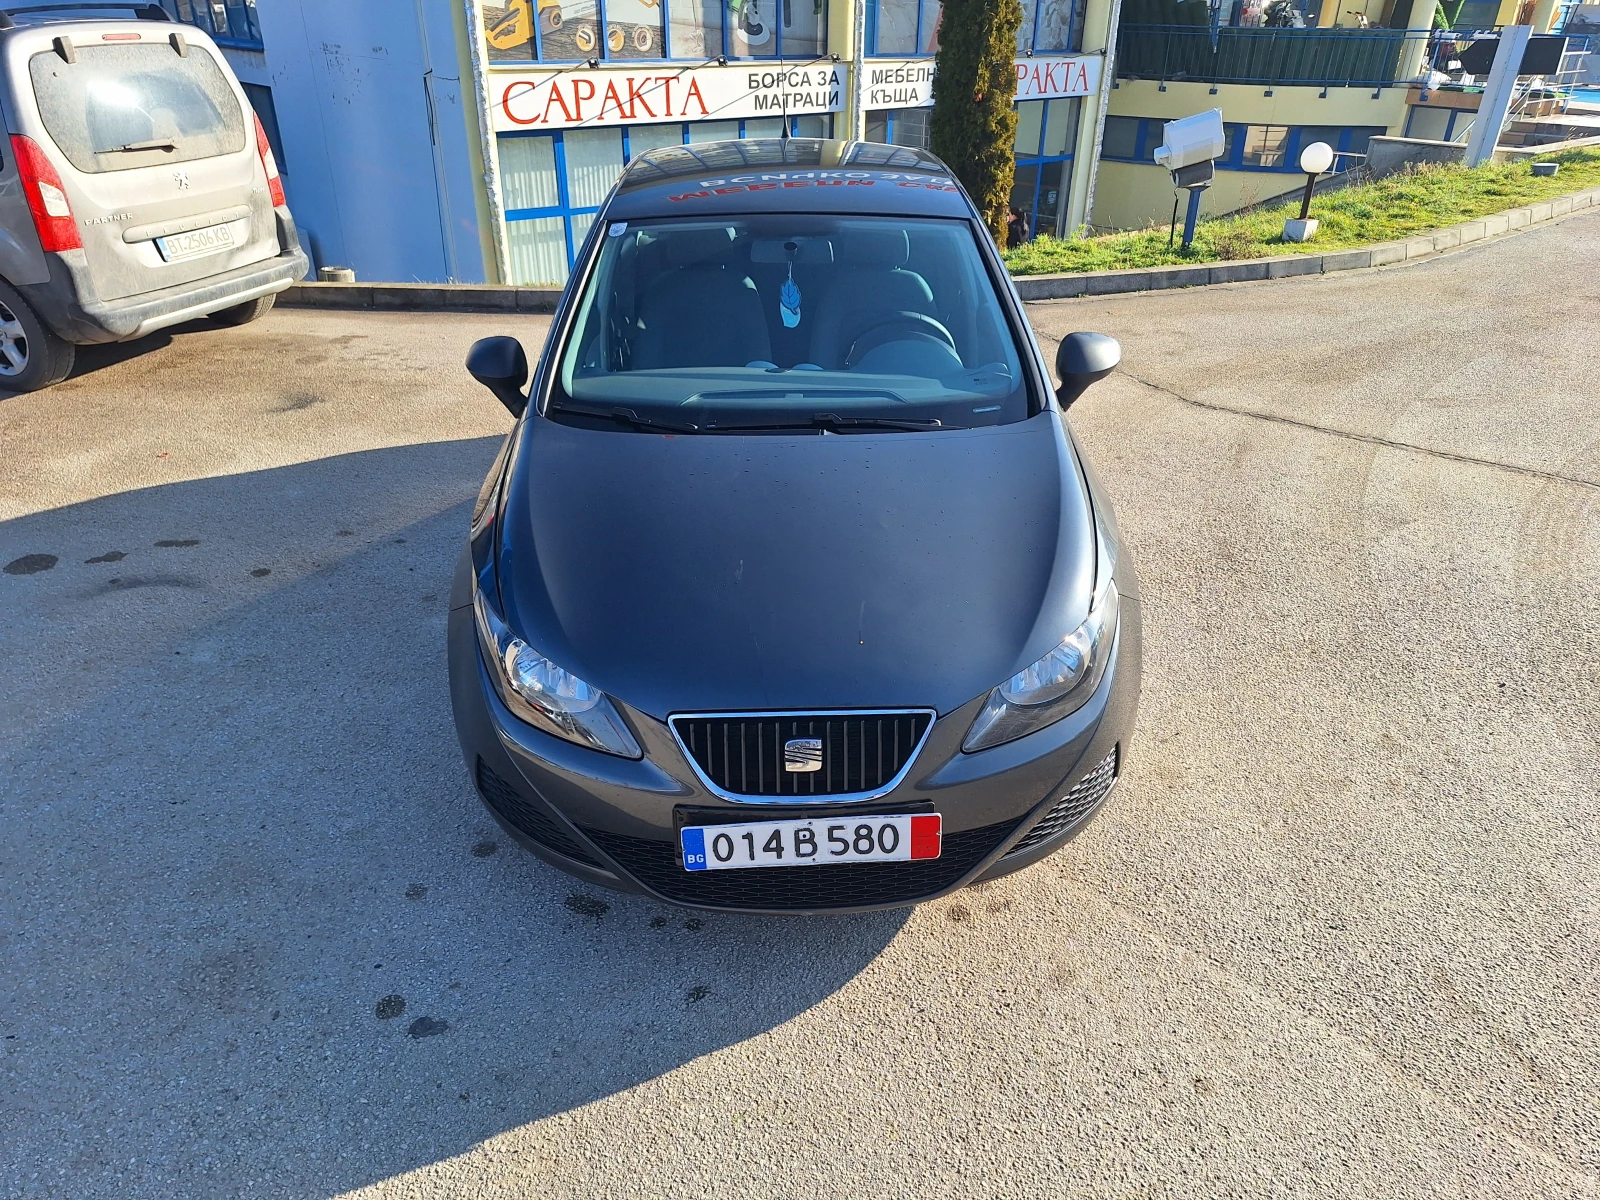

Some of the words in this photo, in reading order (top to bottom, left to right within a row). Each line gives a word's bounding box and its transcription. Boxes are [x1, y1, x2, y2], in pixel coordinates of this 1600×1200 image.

[748, 72, 812, 89] БОРСА
[817, 70, 840, 86] ЗА
[502, 76, 709, 124] САРАКТА
[754, 91, 839, 110] МАТРАЦИ
[870, 88, 919, 104] КЪЩА
[84, 212, 134, 226] PARTNER
[687, 853, 705, 864] BG
